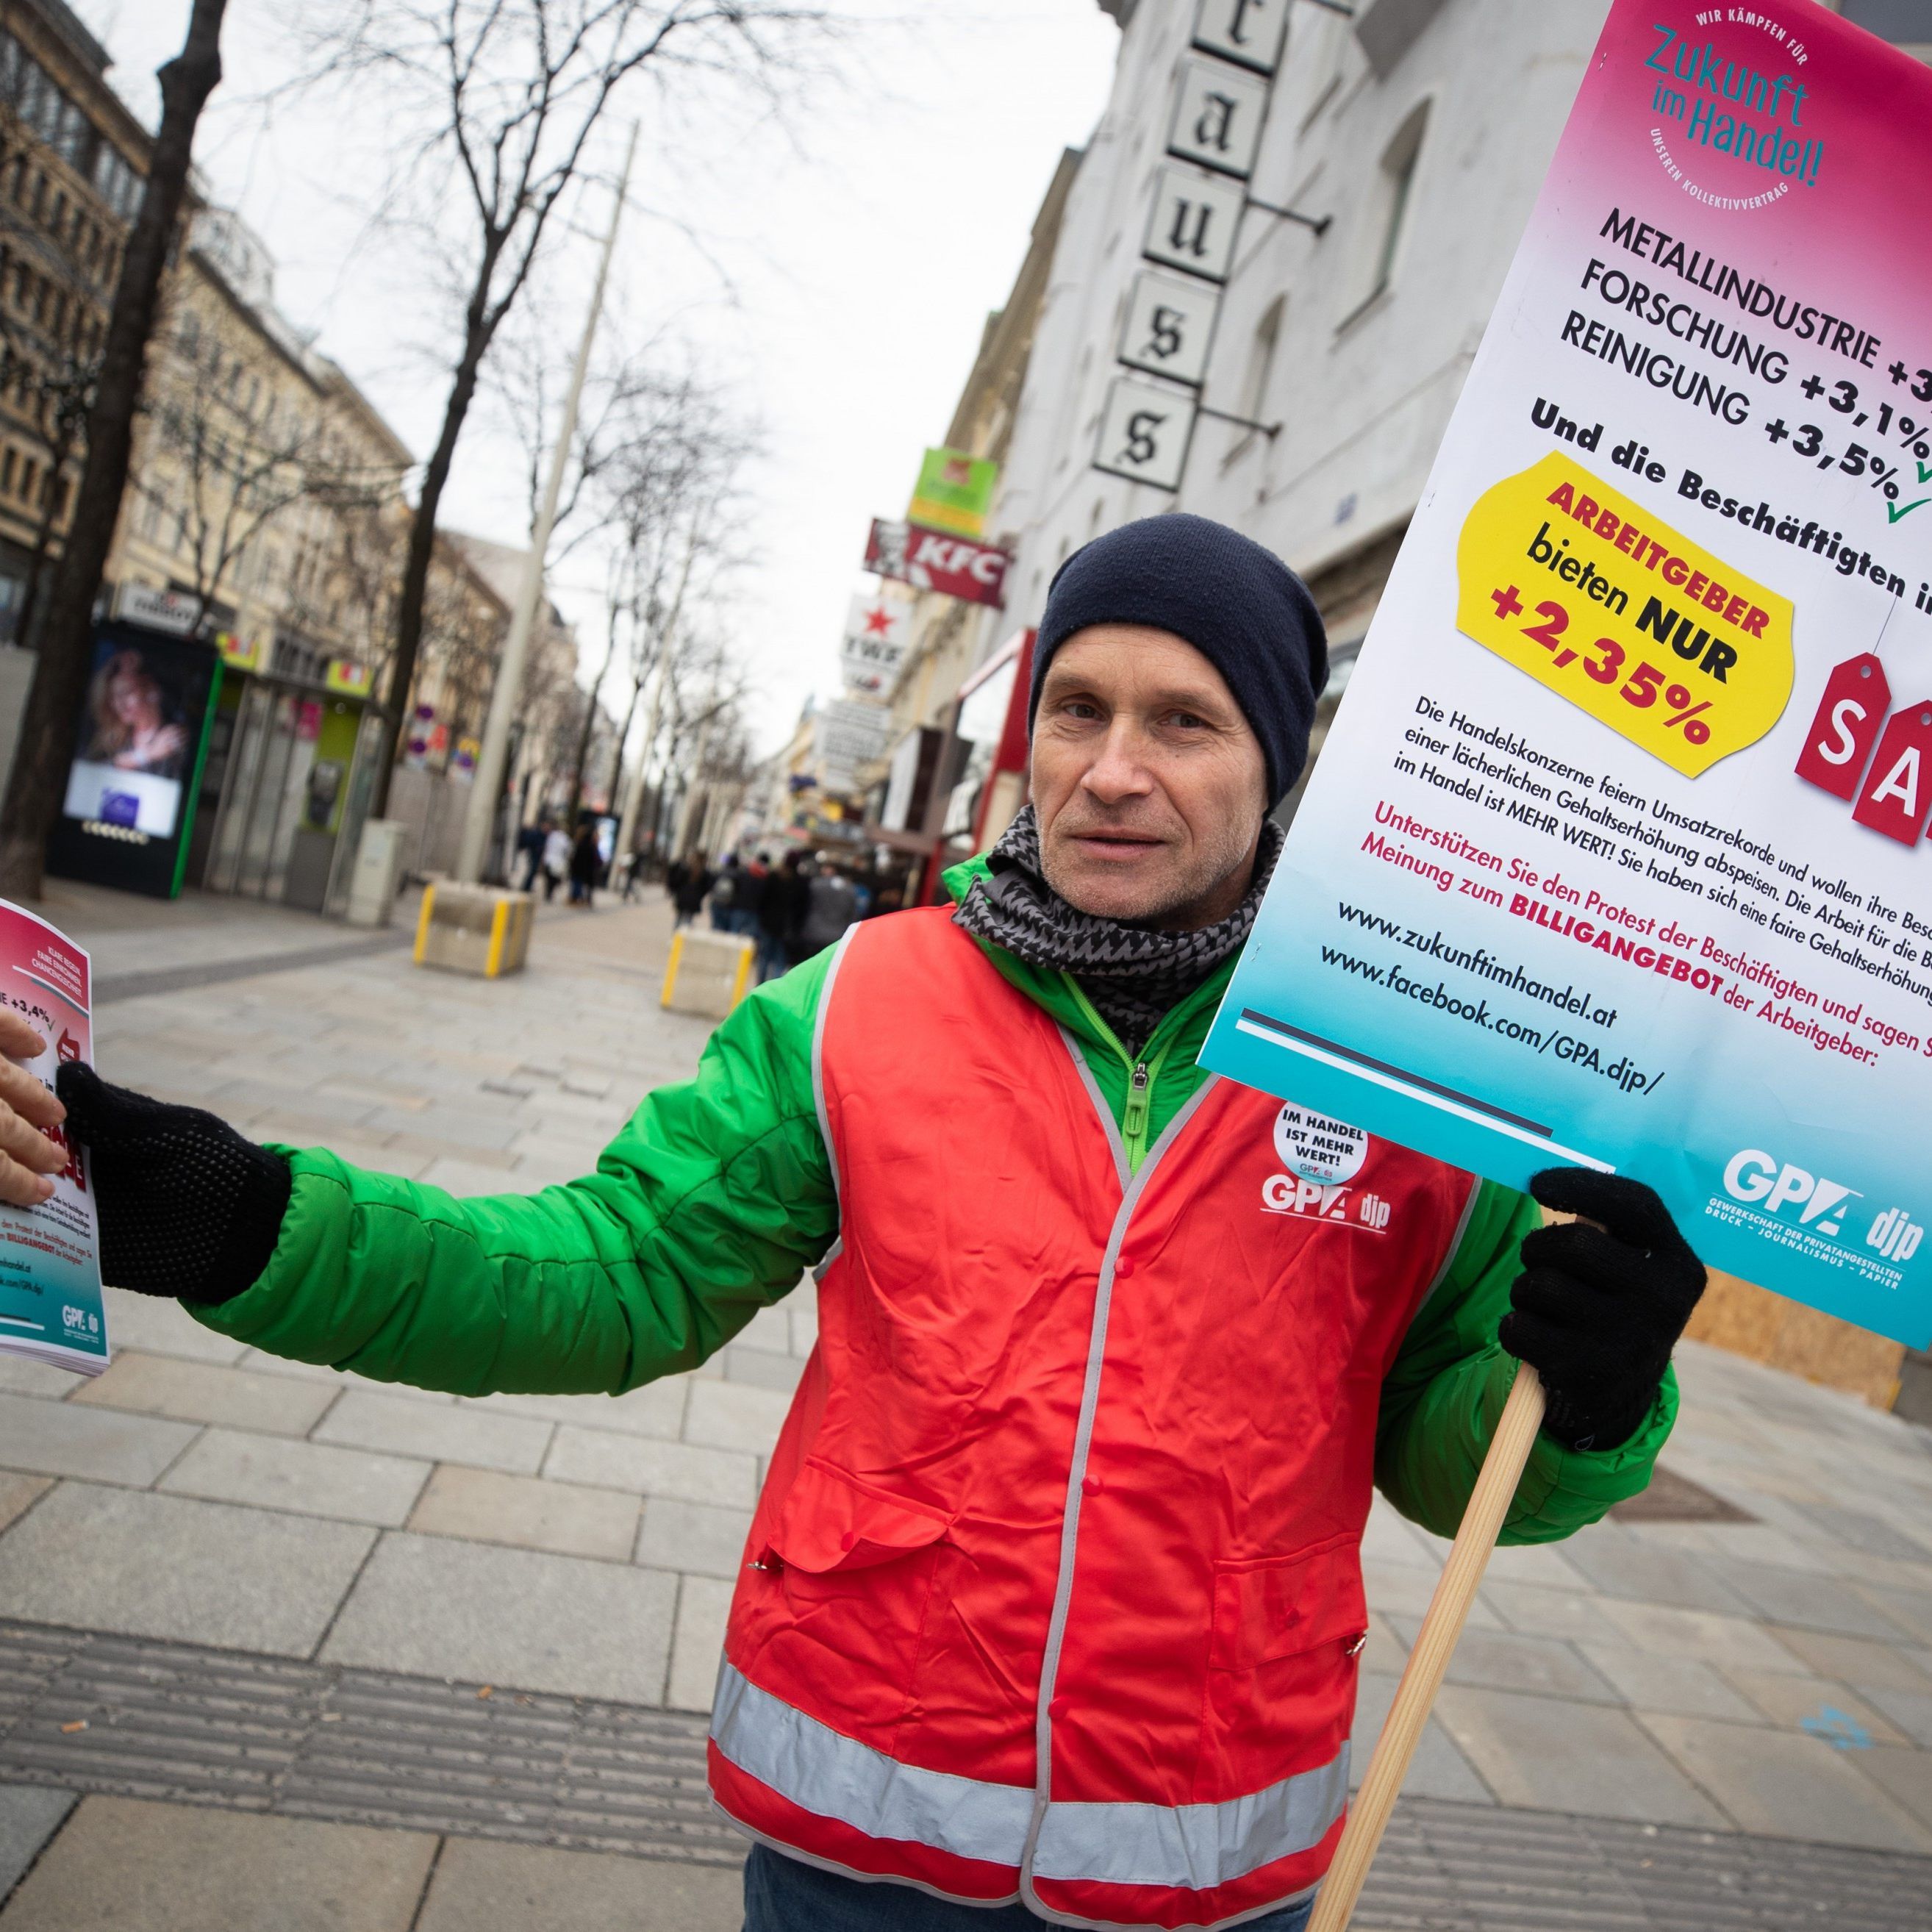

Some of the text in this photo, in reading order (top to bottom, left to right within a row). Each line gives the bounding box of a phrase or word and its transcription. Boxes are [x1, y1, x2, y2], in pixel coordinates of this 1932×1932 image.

[1644, 23, 1809, 126] Zukunft
[1695, 7, 1809, 66] WIR KÄMPFEN FÜR
[1650, 127, 1789, 211] UNSEREN KOLLEKTIVVERTRAG
[1651, 79, 1825, 187] im Handel!
[1599, 207, 1882, 369] METALLINDUSTRIE
[1560, 309, 1900, 501] REINIGUNG +3,5%
[1580, 257, 1931, 459] FORSCHUNG +3,1%
[915, 535, 1005, 585] KFC
[1531, 397, 1604, 454] Und
[1611, 440, 1667, 484] die
[1677, 468, 1906, 598] Beschäftigten
[1545, 482, 1771, 640] ARBEITGEBER
[1490, 584, 1714, 745] +2,35%
[1526, 520, 1739, 684] bieten NUR
[1394, 751, 1416, 776] im
[1419, 762, 1485, 804] Handel
[1484, 789, 1506, 813] ist
[1506, 800, 1559, 837] MEHR
[1563, 822, 1617, 861] WERT!
[1617, 848, 1643, 873] Sie
[1645, 858, 1704, 896] haben
[1707, 885, 1738, 912] sich
[1739, 901, 1768, 926] eine
[1769, 912, 1806, 944] faire
[1405, 726, 1450, 756] einer
[1452, 741, 1552, 802] lächerlichen
[1556, 790, 1700, 867] Gehaltserhöhung
[1704, 852, 1781, 902] abspeisen.
[1784, 889, 1811, 915] Die
[1813, 904, 1865, 939] Arbeit
[1867, 924, 1891, 949] für
[1892, 937, 1917, 962] die
[1415, 695, 1445, 723] Die
[1448, 710, 1595, 789] Handelskonzerne
[1599, 775, 1646, 811] feiern
[1651, 799, 1776, 866] Umsatzrekorde
[1778, 863, 1810, 883] und
[1811, 873, 1862, 908] wollen
[1867, 895, 1897, 923] ihre
[1338, 901, 1618, 1028] www.zukunftimhandel.at
[1360, 831, 1880, 1067] Meinung zum BILLIGANGEBOT der Arbeitgeber:
[1374, 800, 1503, 873] Unterstützen
[1507, 857, 1539, 887] Sie
[1542, 872, 1581, 906] den
[1584, 890, 1656, 936] Protest
[1658, 921, 1698, 951] der
[1700, 936, 1819, 1008] Beschäftigten
[1822, 998, 1864, 1026] und
[1861, 1015, 1920, 1052] sagen
[1321, 945, 1666, 1096] www.facebook.com/GPA.djp/
[1282, 1109, 1364, 1141] IM HANDEL
[1286, 1128, 1354, 1156] IST MEHR
[1295, 1145, 1341, 1167] WERT!
[1360, 1192, 1391, 1229] djp
[1704, 1205, 1742, 1227] DRUCK
[1758, 1228, 1844, 1268] JOURNALISMUS
[1858, 1267, 1900, 1290] PAPIER
[1709, 1197, 1903, 1281] GEWERKSCHAFT DER PRIVATANGESTELLTEN
[1865, 1207, 1925, 1262] djp
